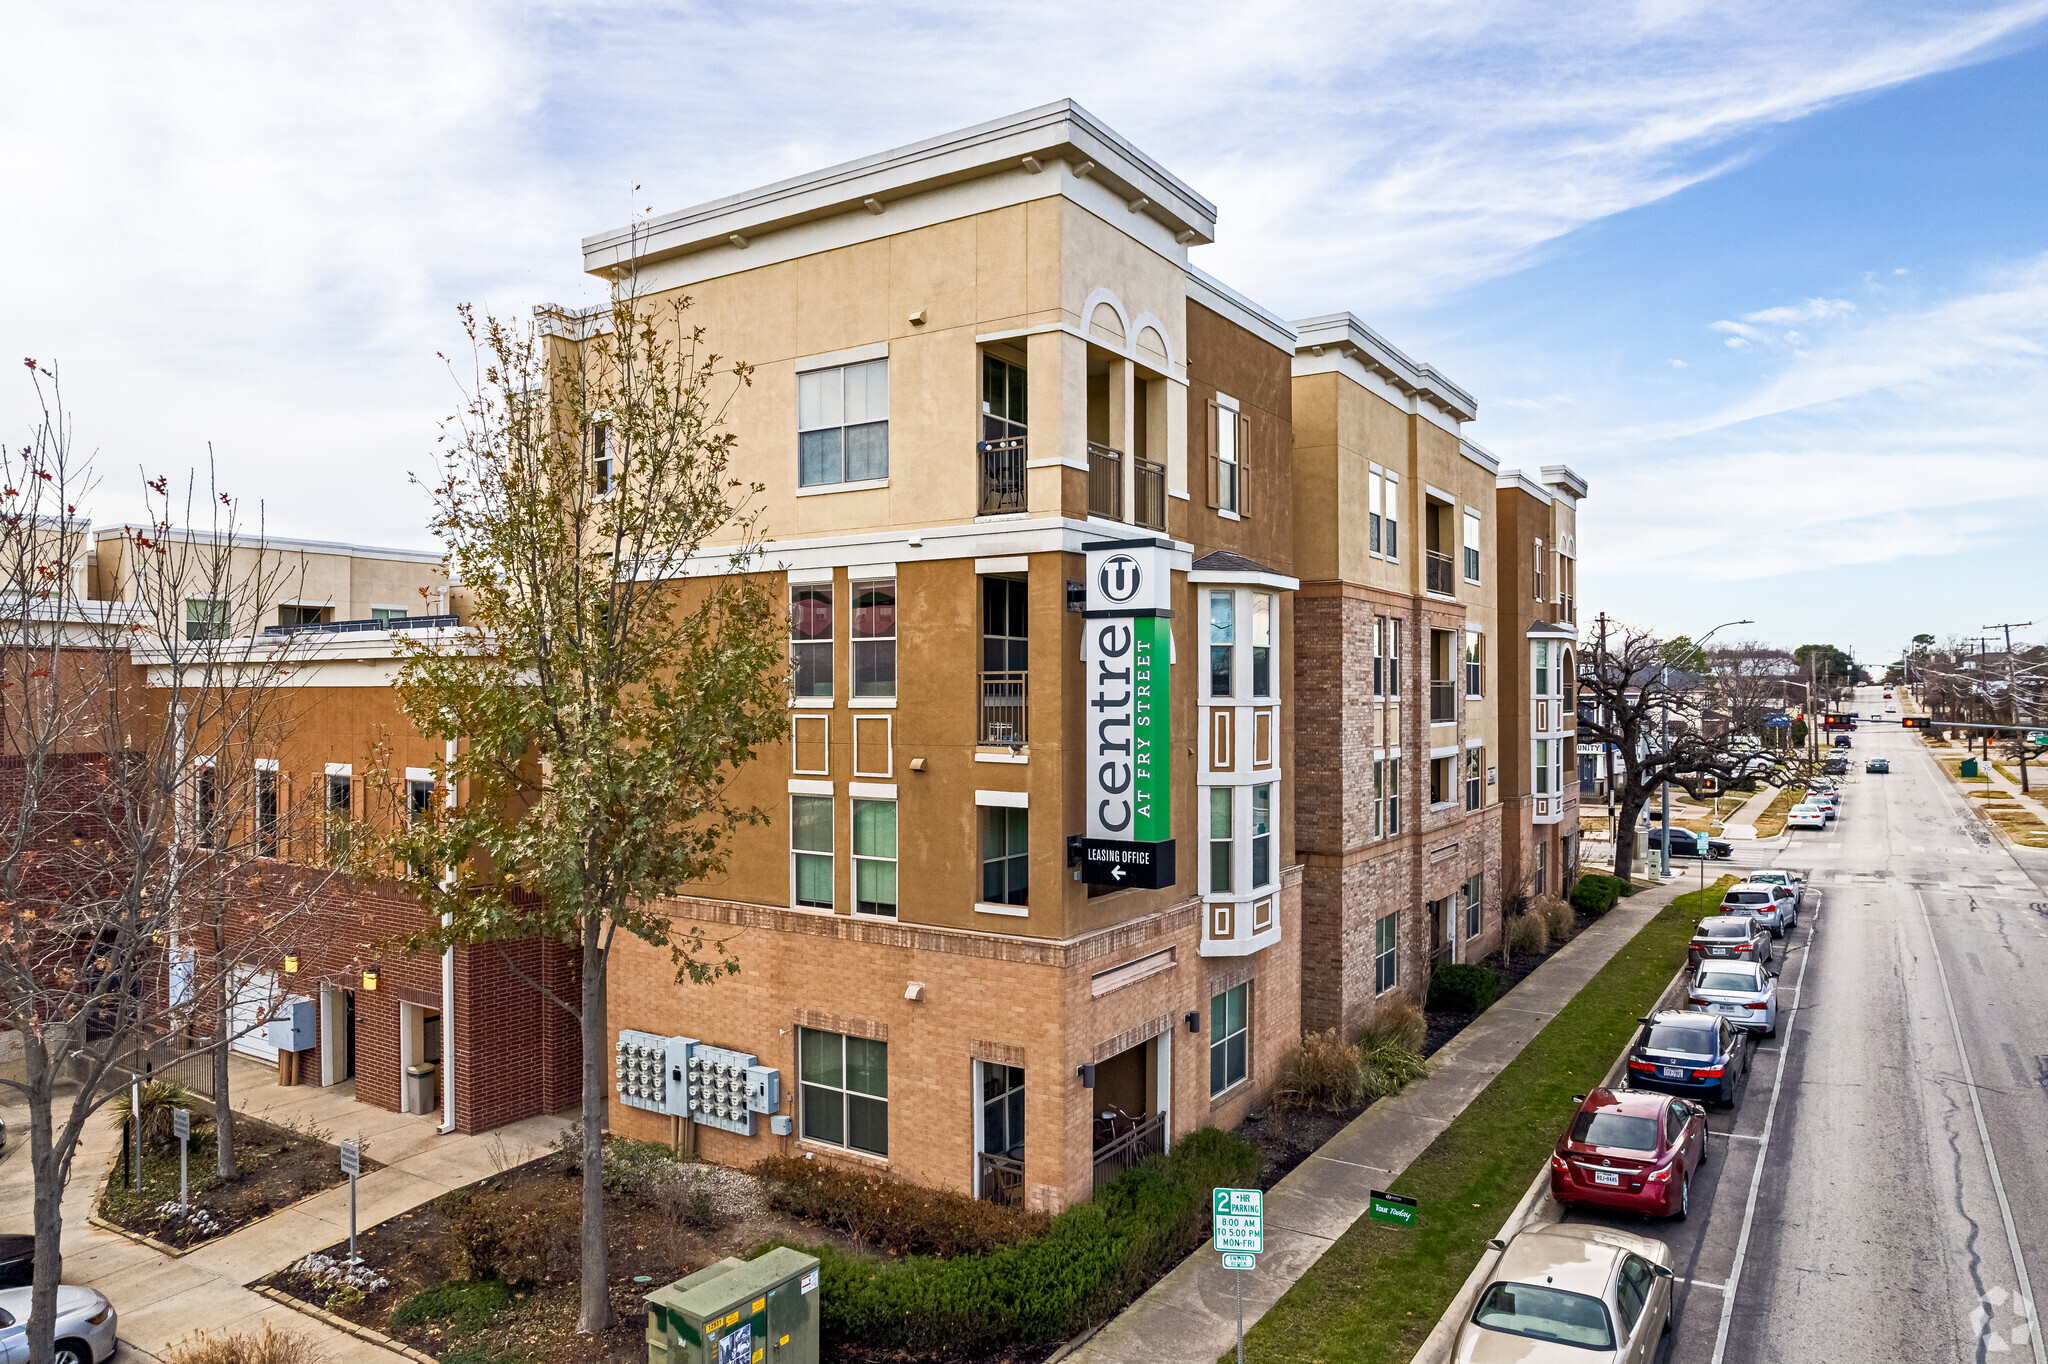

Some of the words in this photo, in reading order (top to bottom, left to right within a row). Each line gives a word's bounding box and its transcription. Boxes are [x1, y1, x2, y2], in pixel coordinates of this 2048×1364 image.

[1104, 561, 1136, 600] U
[1137, 640, 1150, 726] STREET
[1090, 624, 1132, 833] centre
[1137, 737, 1150, 779] FRY
[1137, 789, 1150, 818] AT
[1087, 848, 1120, 863] LEASING
[1121, 850, 1150, 865] OFFICE
[1217, 1191, 1230, 1212] 2
[1240, 1194, 1251, 1203] HR
[1231, 1203, 1259, 1214] PARKING
[1221, 1217, 1239, 1226] 8:00
[1243, 1219, 1255, 1227] AM
[1374, 1203, 1389, 1214] Tour
[1389, 1207, 1412, 1222] Today
[1217, 1227, 1227, 1236] TO
[1229, 1228, 1246, 1237] 5:00
[1248, 1229, 1260, 1238] PM
[1222, 1238, 1255, 1248] MON-FRI
